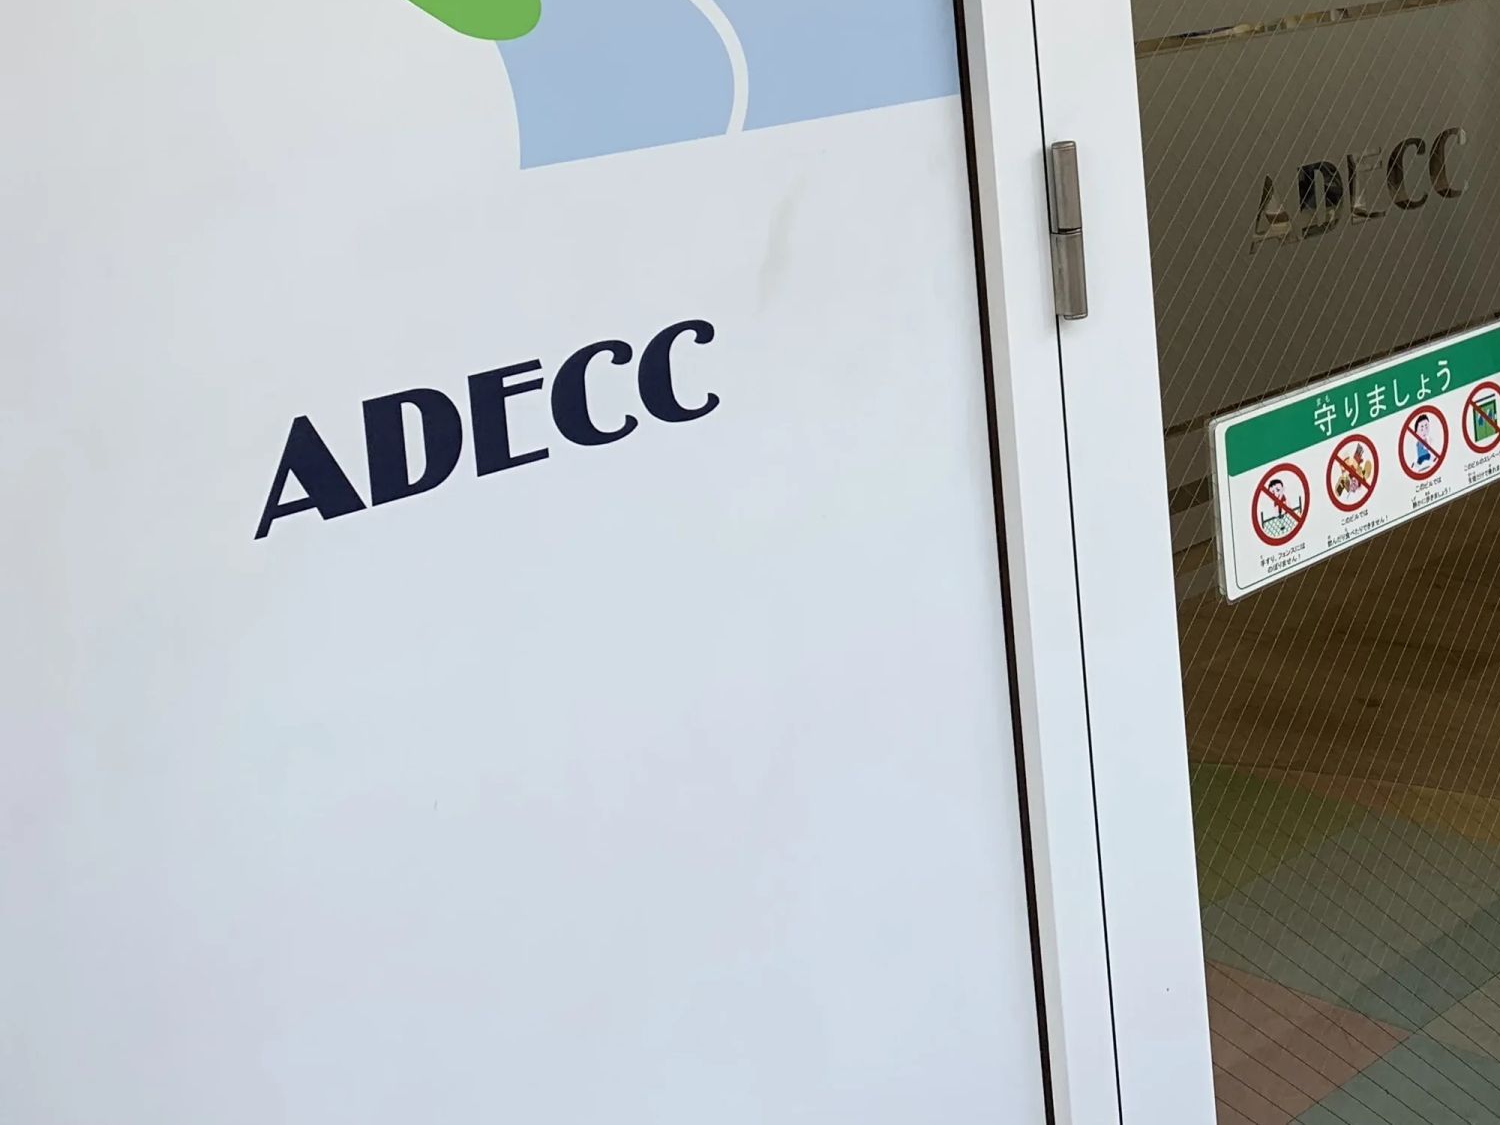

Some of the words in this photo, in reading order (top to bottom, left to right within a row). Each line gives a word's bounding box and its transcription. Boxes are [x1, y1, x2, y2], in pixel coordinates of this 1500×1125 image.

[1250, 126, 1469, 254] ADECC
[254, 319, 720, 540] ADECC
[1314, 360, 1451, 436] 守りましょう
